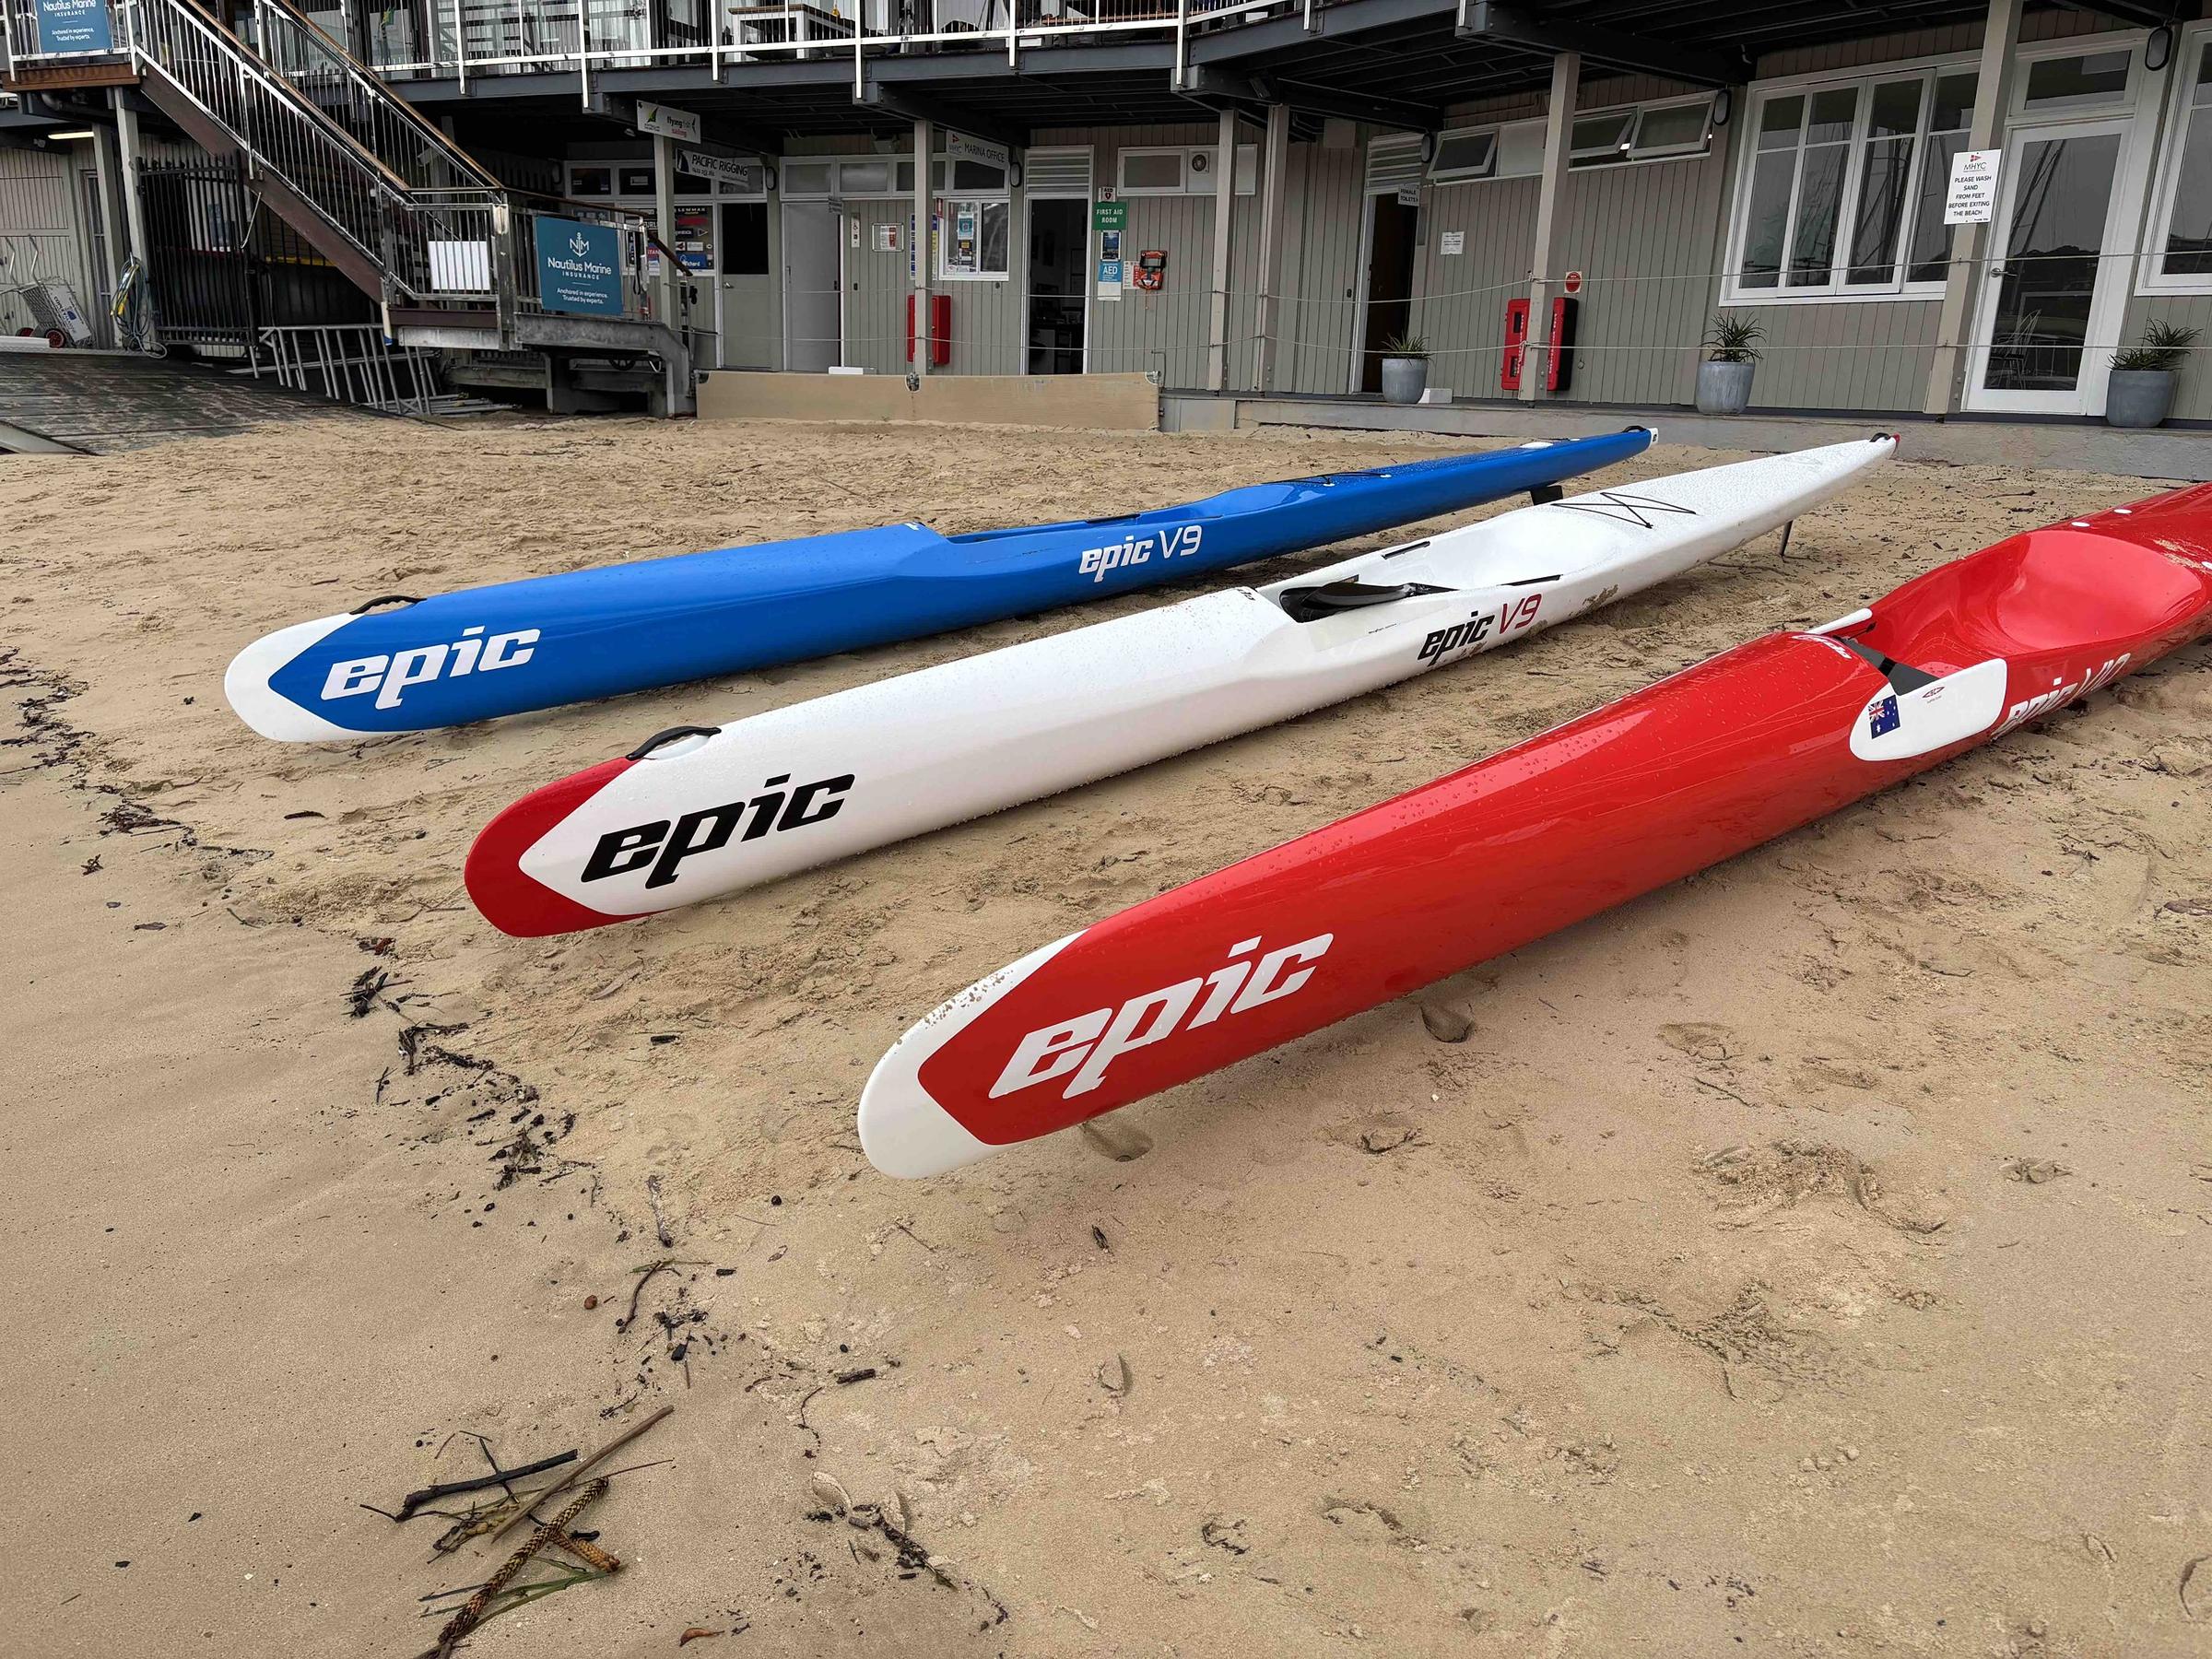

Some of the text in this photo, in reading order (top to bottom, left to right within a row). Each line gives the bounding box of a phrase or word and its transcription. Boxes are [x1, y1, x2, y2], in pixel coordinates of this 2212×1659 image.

[964, 143, 986, 158] MARINA
[986, 148, 1005, 163] OFFICE
[692, 154, 718, 170] PACIFIC
[719, 160, 748, 177] RIGGING
[1963, 162, 1987, 171] MHYC
[547, 256, 612, 276] Nautilus Marine
[562, 271, 600, 280] INSURANCE
[1102, 265, 1118, 275] AED
[556, 287, 579, 296] Anchored
[562, 294, 580, 302] Trusted
[1078, 524, 1203, 583] epic V9
[1417, 593, 1543, 666] epic V9
[320, 625, 542, 711] epic
[580, 772, 856, 890] epic
[987, 933, 1335, 1100] epic
